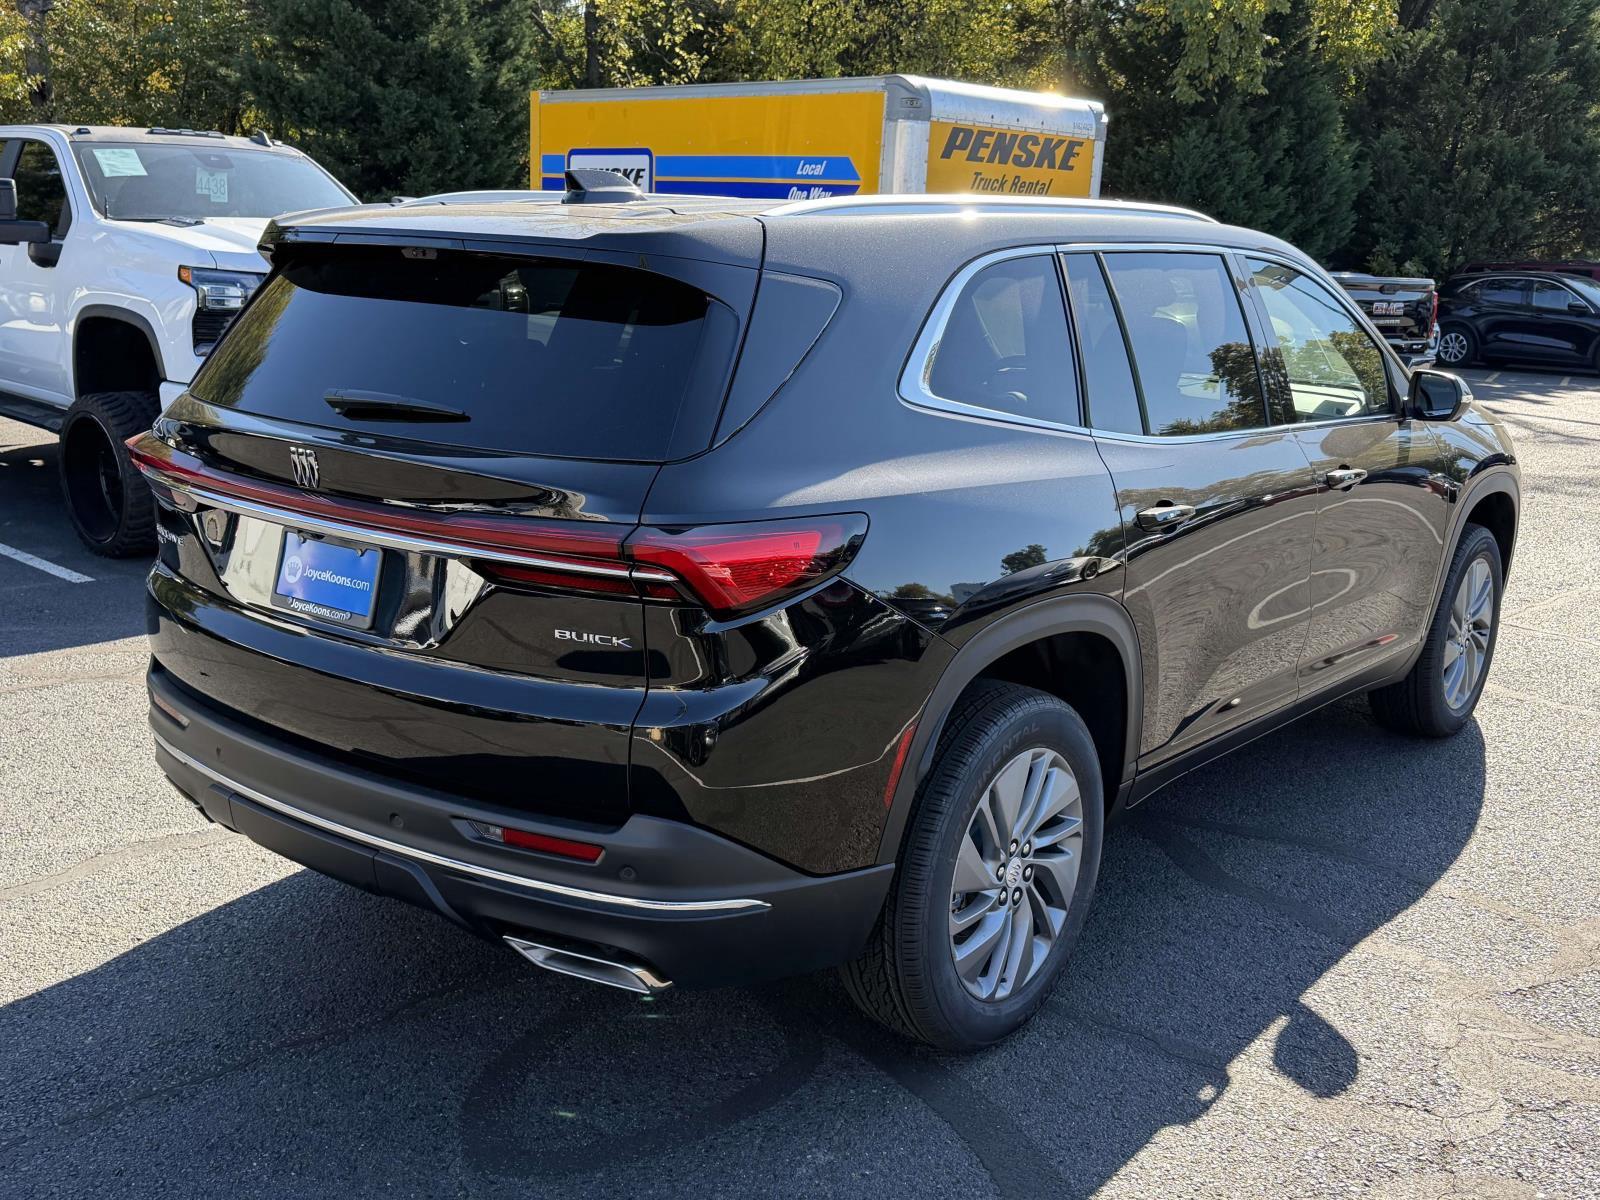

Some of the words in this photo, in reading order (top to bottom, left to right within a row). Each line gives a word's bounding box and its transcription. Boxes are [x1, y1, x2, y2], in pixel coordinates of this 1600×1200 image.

[940, 126, 1084, 171] PENSKE
[796, 160, 827, 175] Local
[788, 186, 808, 200] One
[970, 172, 1008, 192] Truck
[1009, 175, 1054, 195] Rental
[1373, 302, 1404, 315] GMC
[303, 565, 370, 591] JoyceKoons.com
[290, 598, 347, 620] JoyceKoons.com
[554, 629, 633, 649] BUICK
